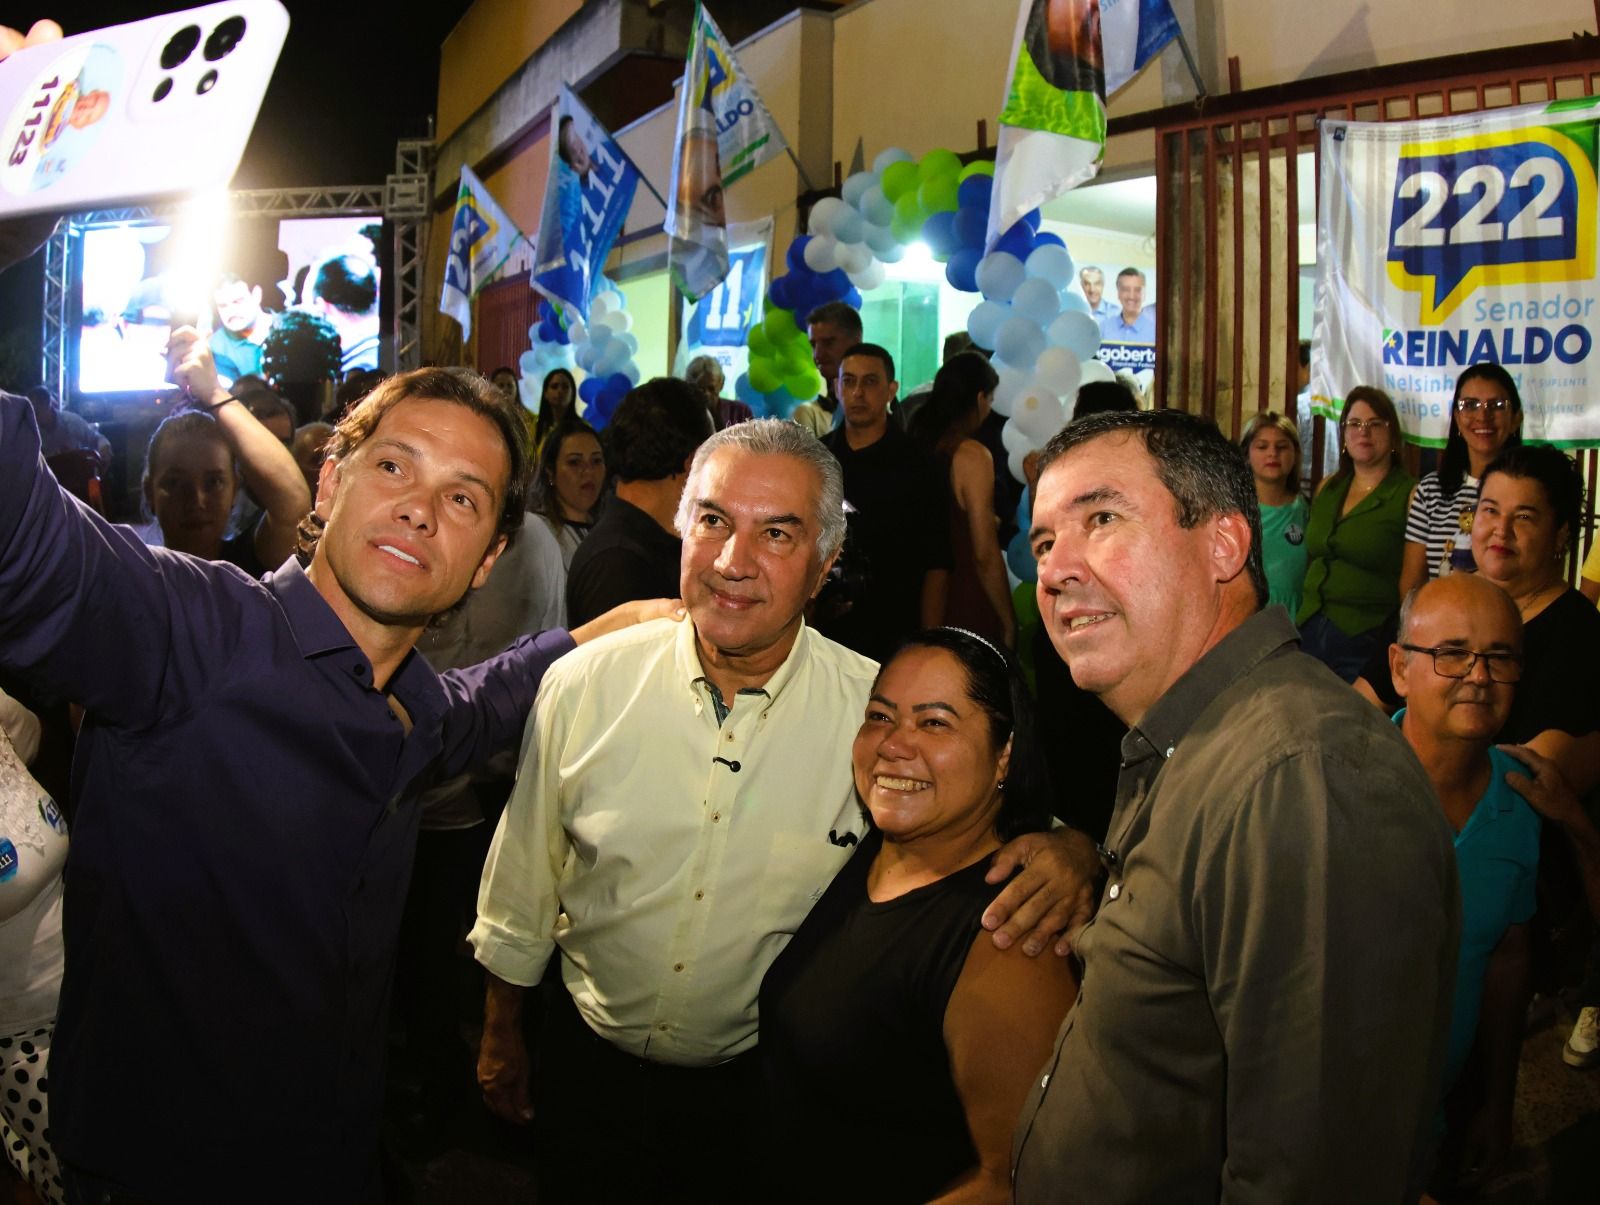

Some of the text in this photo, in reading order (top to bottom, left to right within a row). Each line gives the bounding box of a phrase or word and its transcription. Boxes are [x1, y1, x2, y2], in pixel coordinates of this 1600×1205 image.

[9, 76, 59, 166] 11123
[716, 99, 754, 137] LDO
[1394, 156, 1565, 247] 222
[705, 260, 744, 330] 11
[1474, 293, 1595, 322] Senador
[1382, 324, 1592, 367] REINALDO
[1392, 397, 1441, 419] elipe
